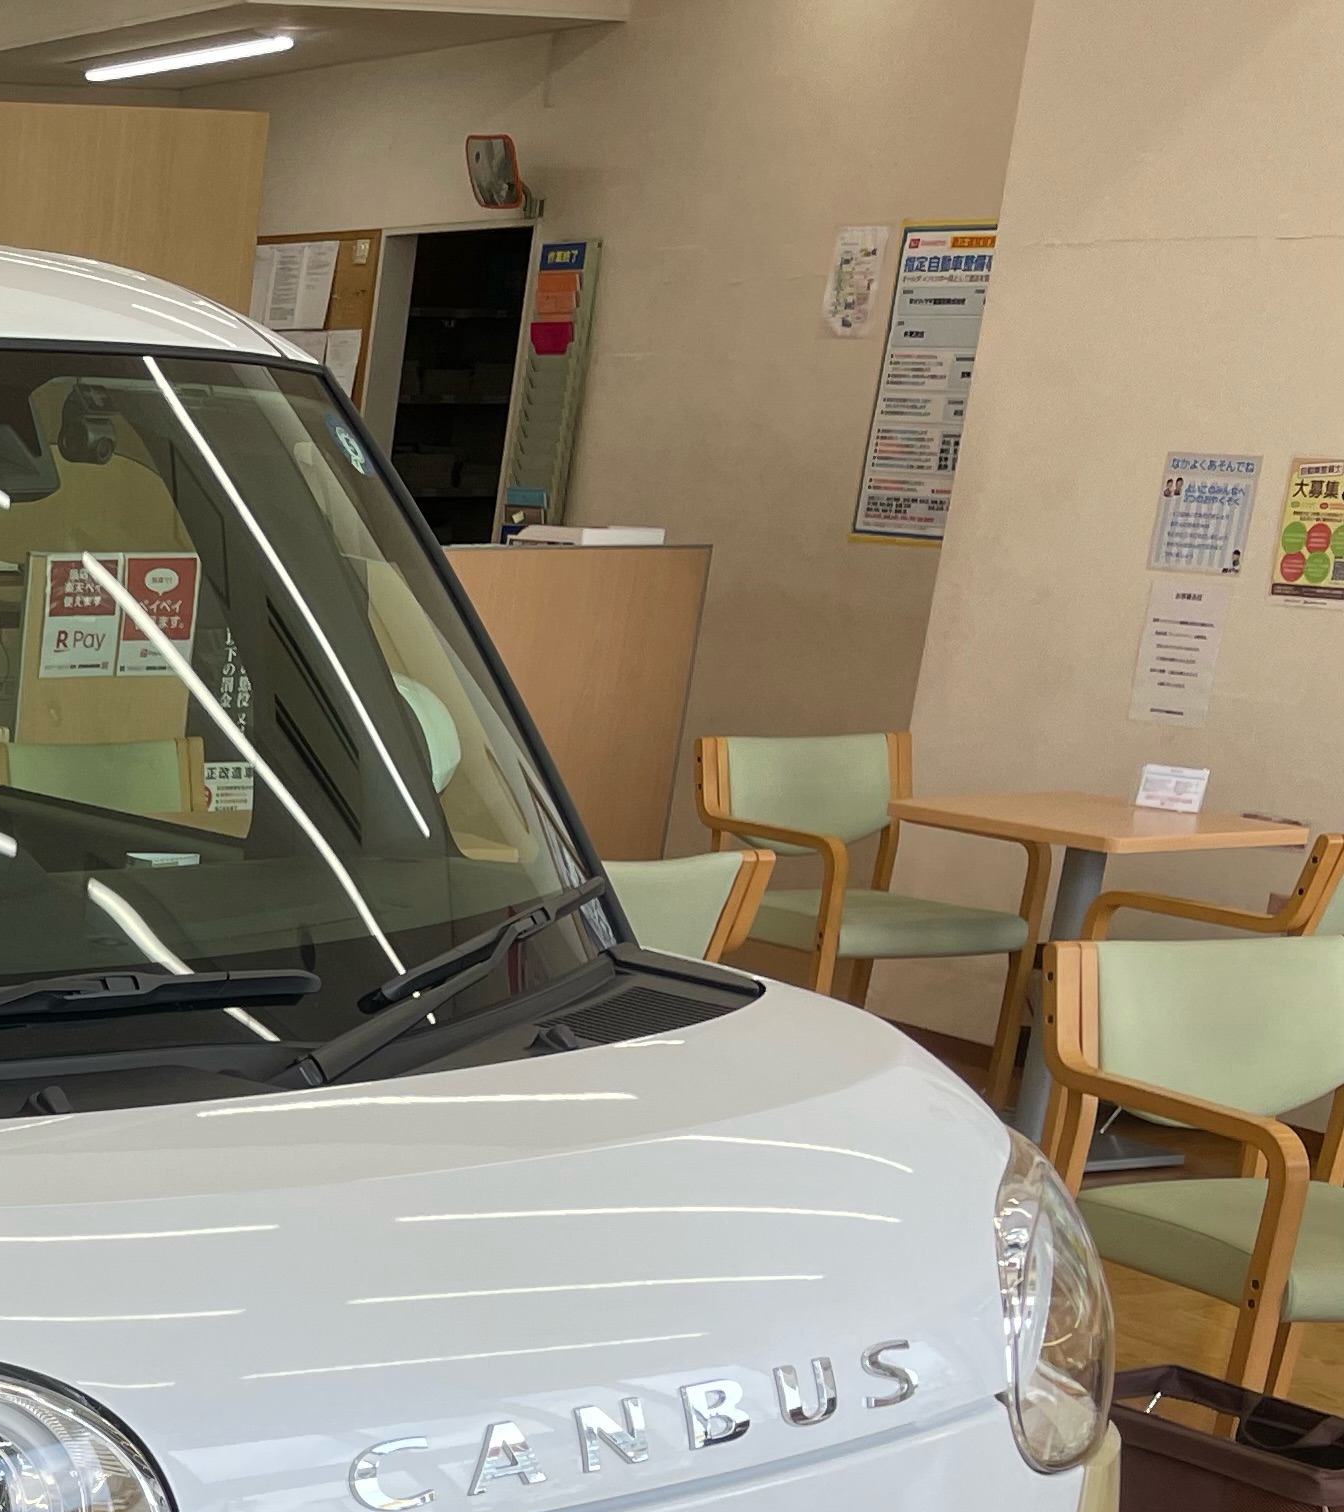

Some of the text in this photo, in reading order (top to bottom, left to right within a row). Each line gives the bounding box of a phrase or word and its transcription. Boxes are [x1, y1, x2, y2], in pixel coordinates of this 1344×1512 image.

[1172, 458, 1255, 473] なかよくあそんでね
[73, 631, 106, 651] Pay
[348, 1338, 920, 1512] CANBUS
